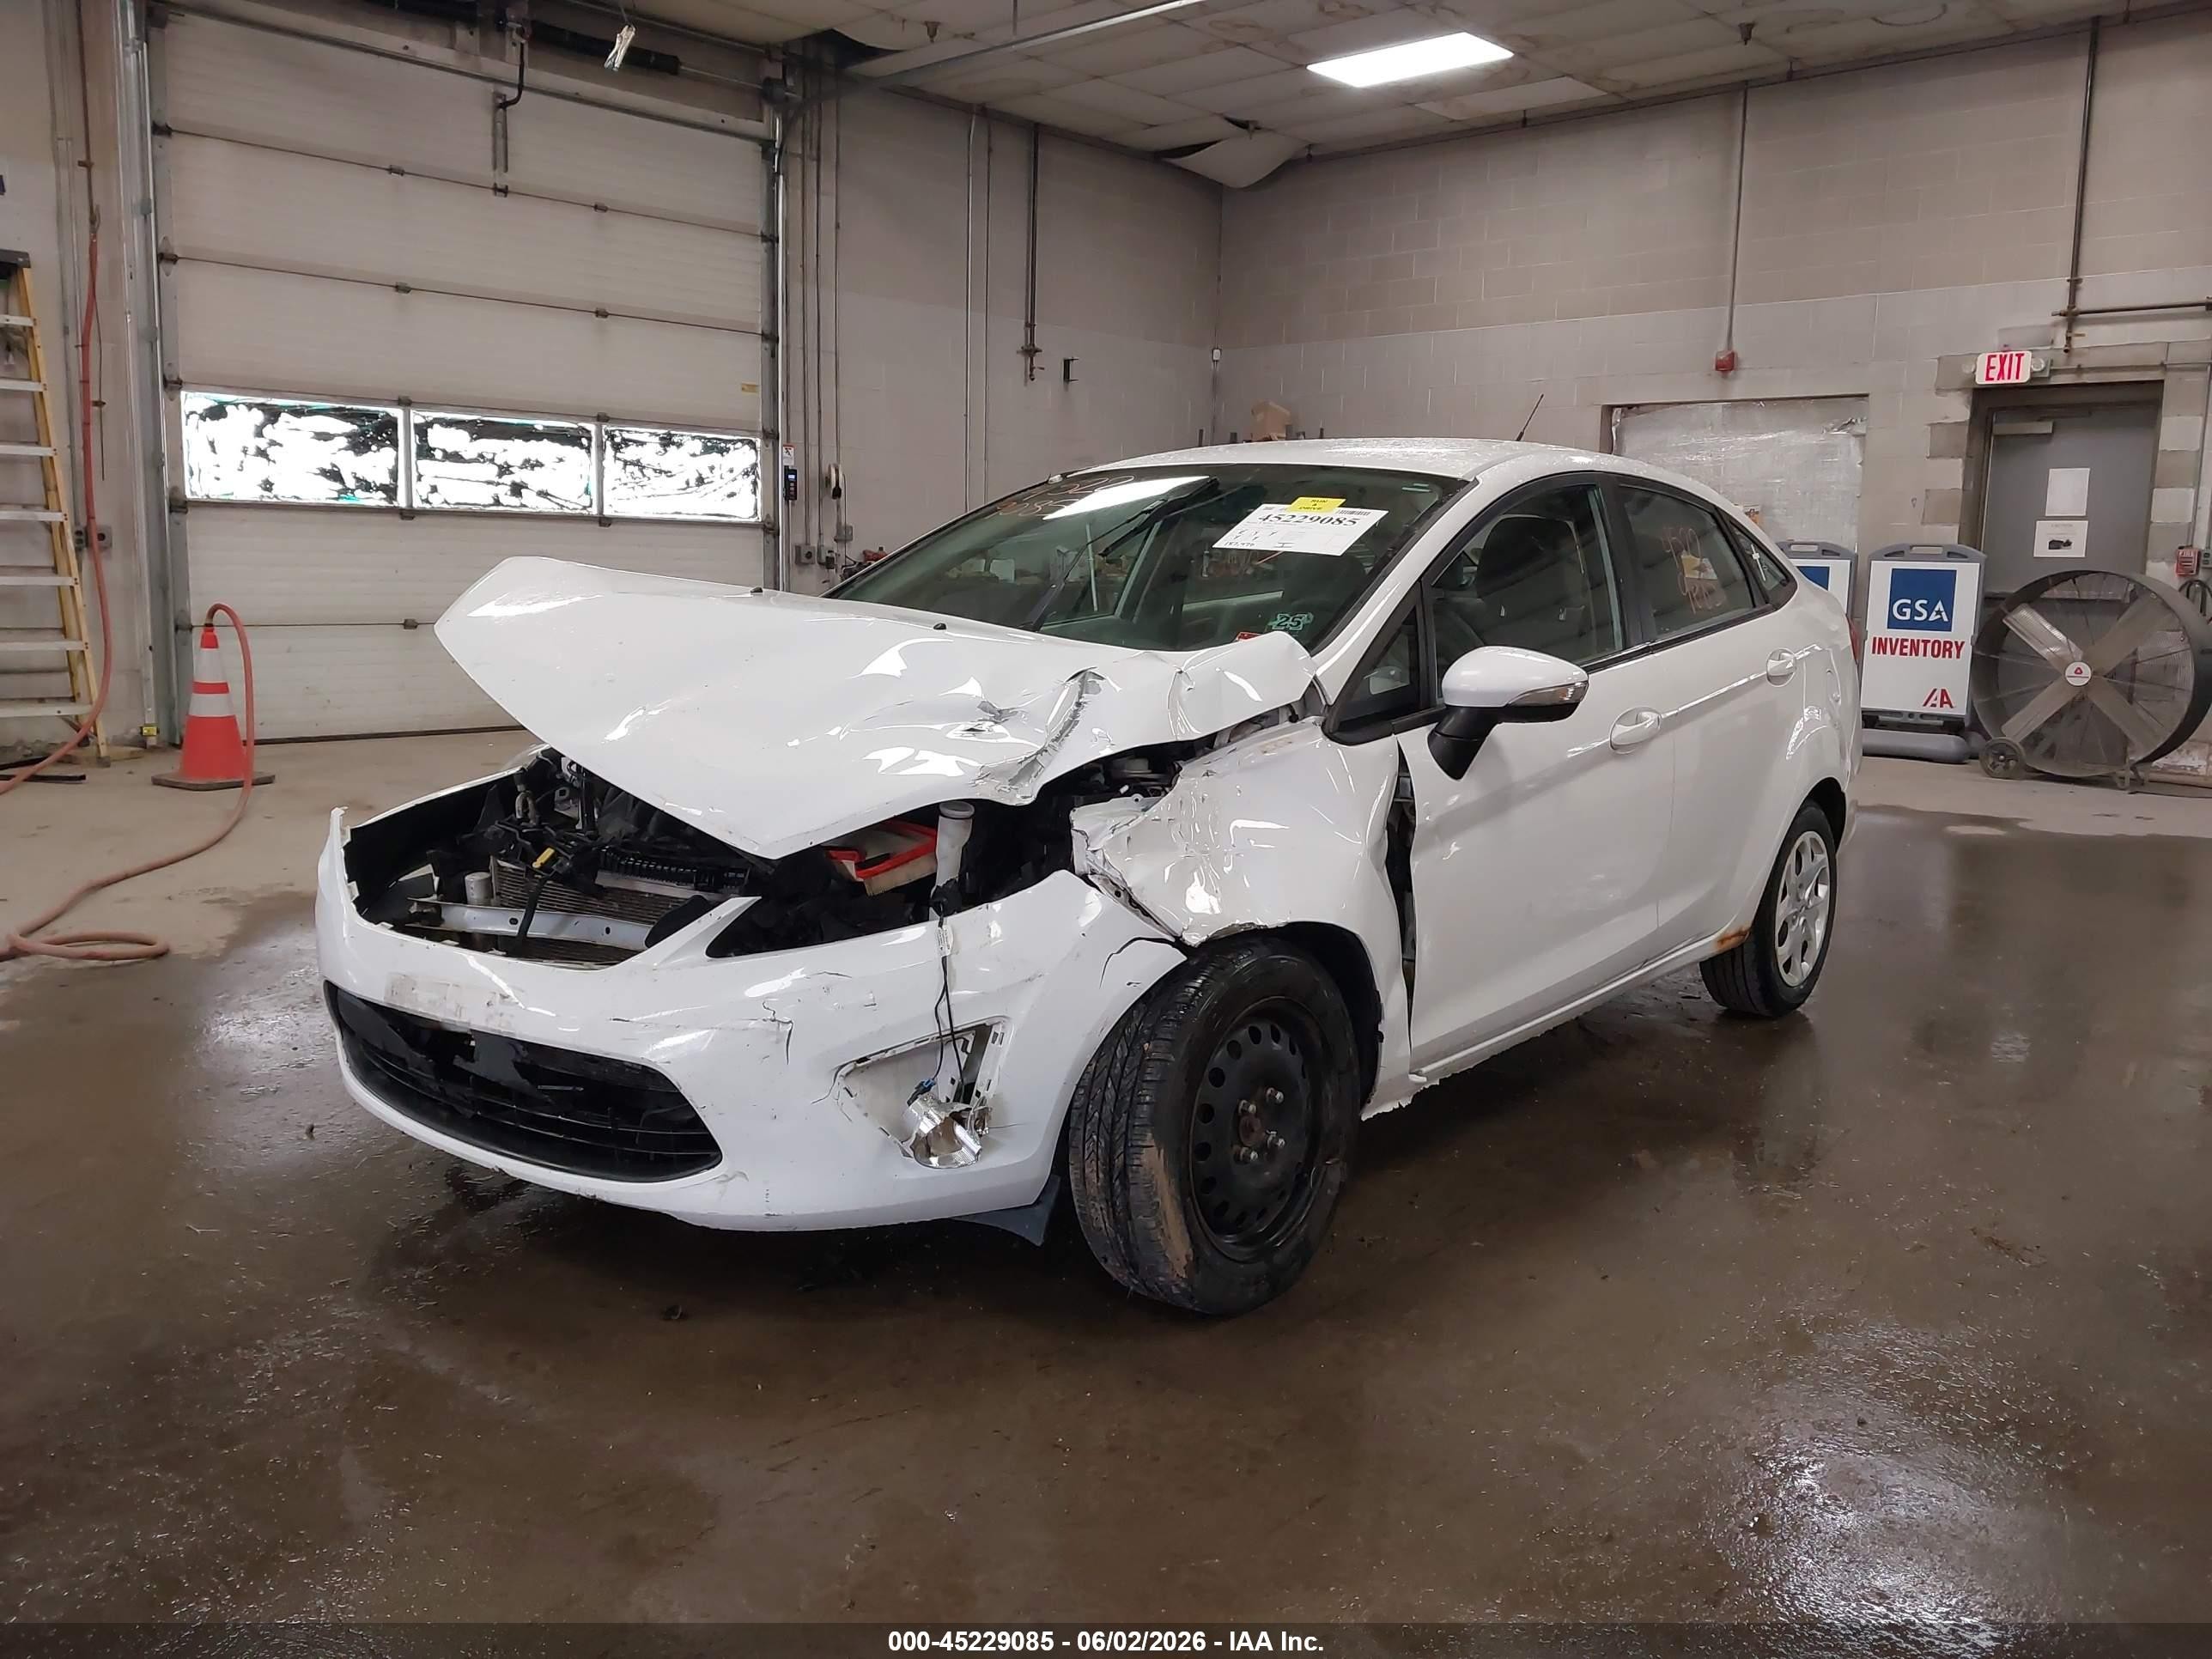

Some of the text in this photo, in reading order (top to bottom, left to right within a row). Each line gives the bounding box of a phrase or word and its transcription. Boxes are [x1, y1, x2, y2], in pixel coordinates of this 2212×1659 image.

[1984, 353, 2025, 381] EXIT
[1259, 514, 1361, 526] 45229085
[1278, 616, 1303, 628] 25
[1892, 599, 1949, 623] GSA
[1871, 636, 1966, 659] INVENTORY
